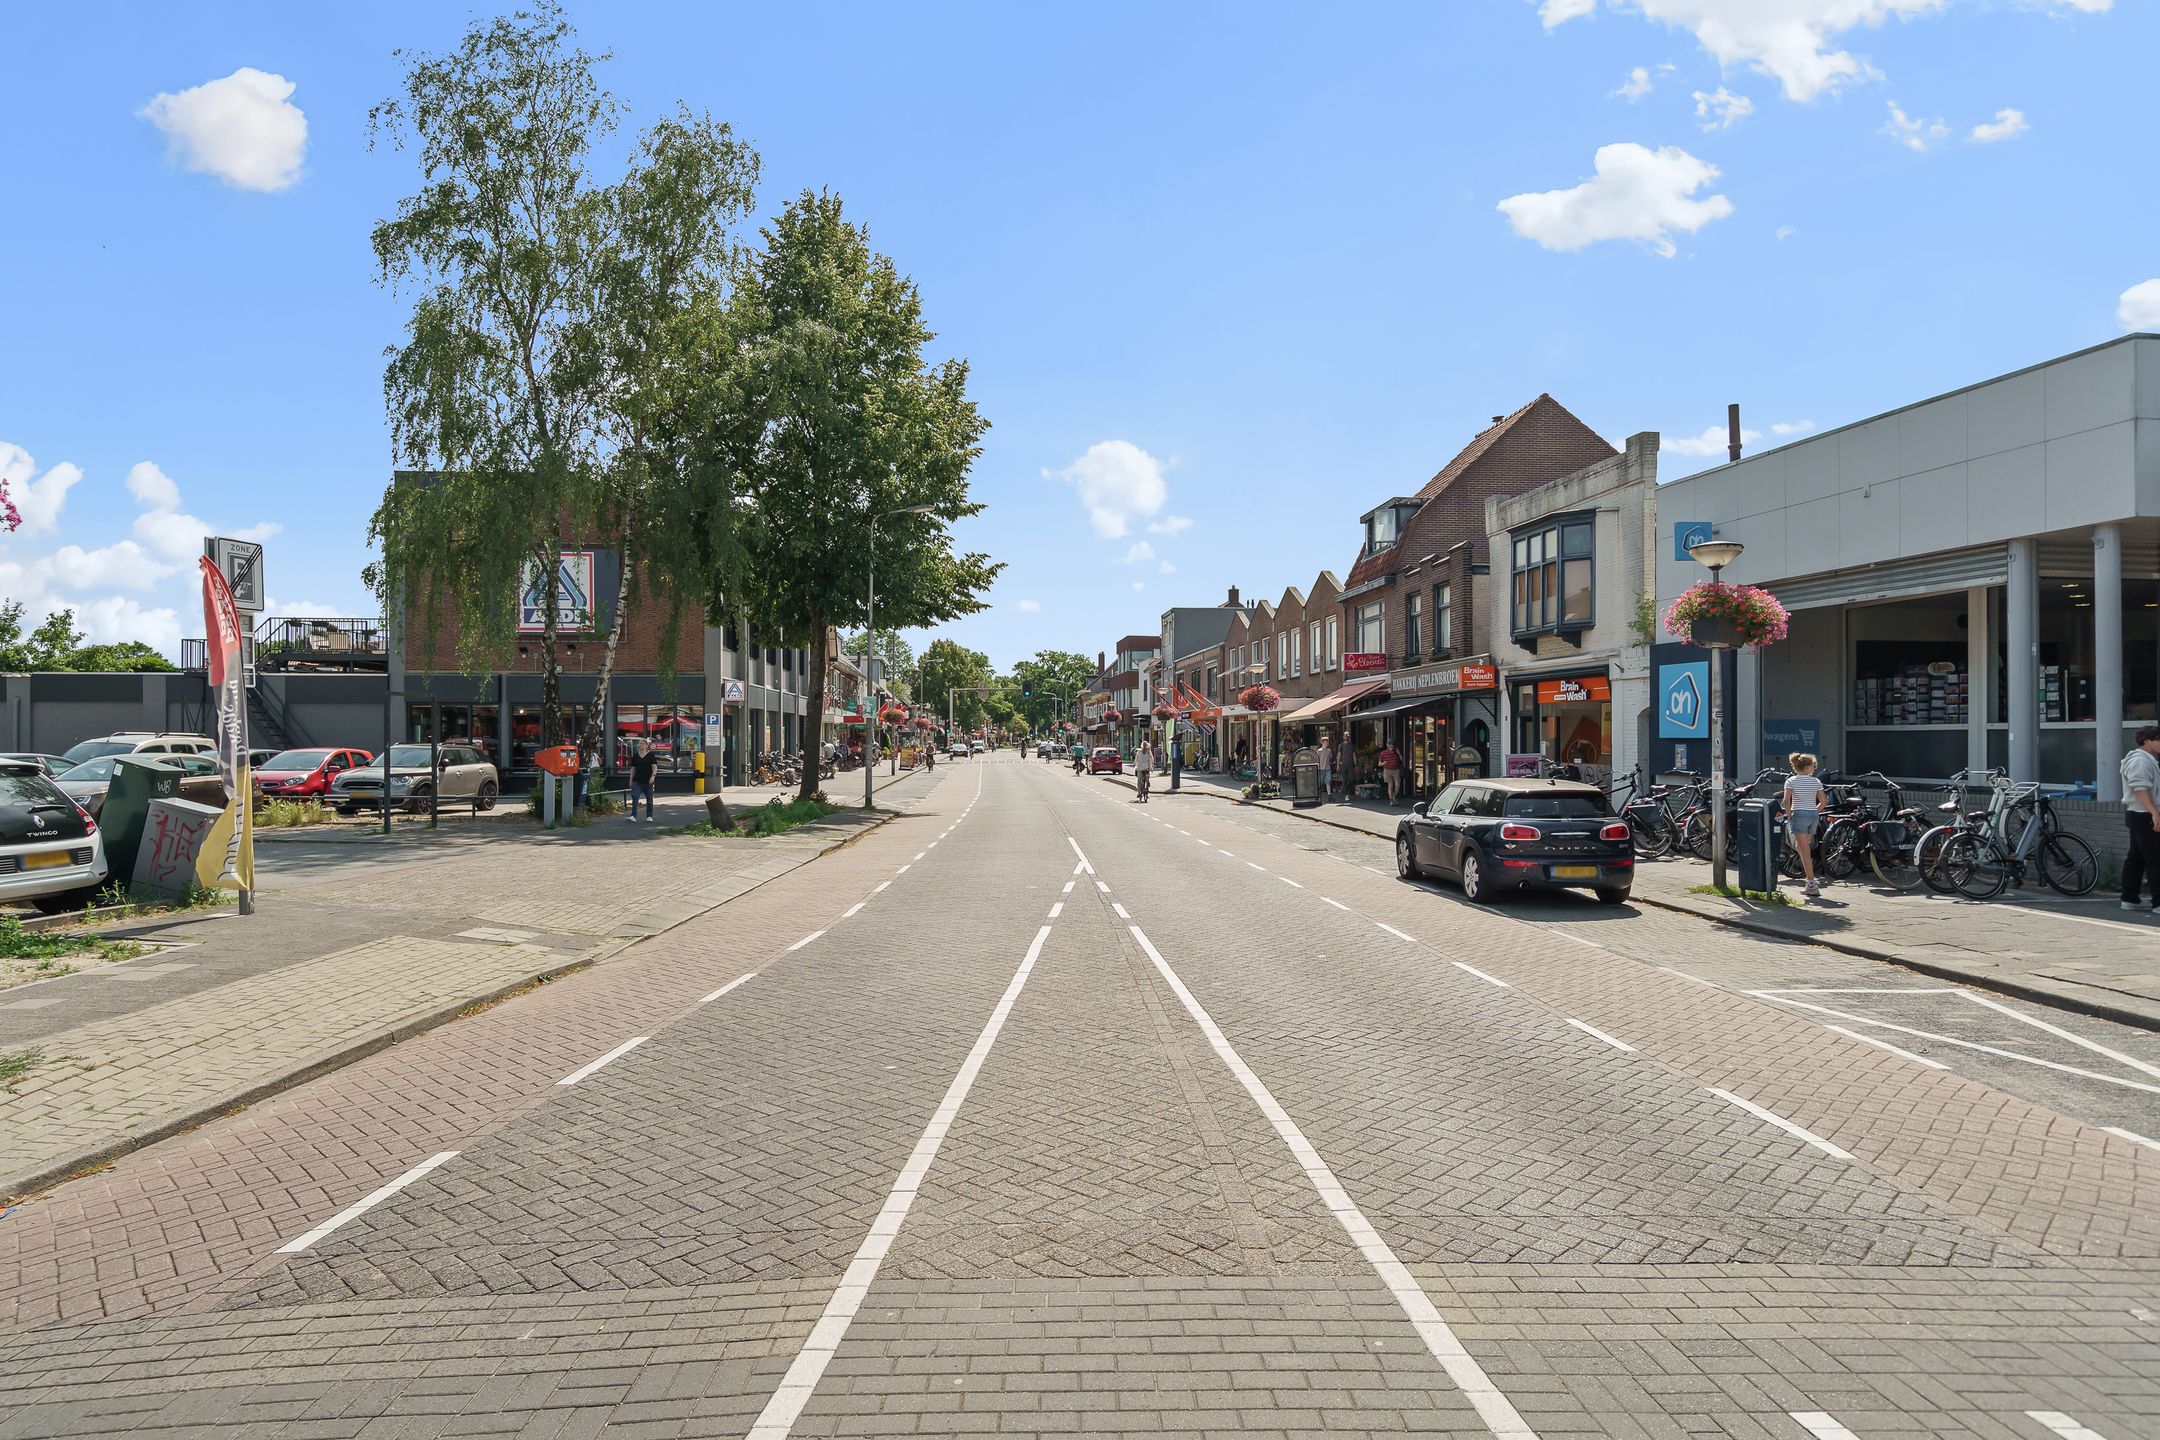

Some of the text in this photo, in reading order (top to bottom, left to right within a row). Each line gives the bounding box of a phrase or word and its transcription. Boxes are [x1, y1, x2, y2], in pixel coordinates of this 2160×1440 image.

[230, 543, 251, 553] ZONE
[1463, 666, 1485, 674] Brain
[1471, 672, 1493, 680] Wash
[1392, 675, 1417, 692] BAKKERIJ
[1560, 680, 1579, 692] Brain
[1566, 689, 1587, 701] Wash
[709, 715, 717, 724] P
